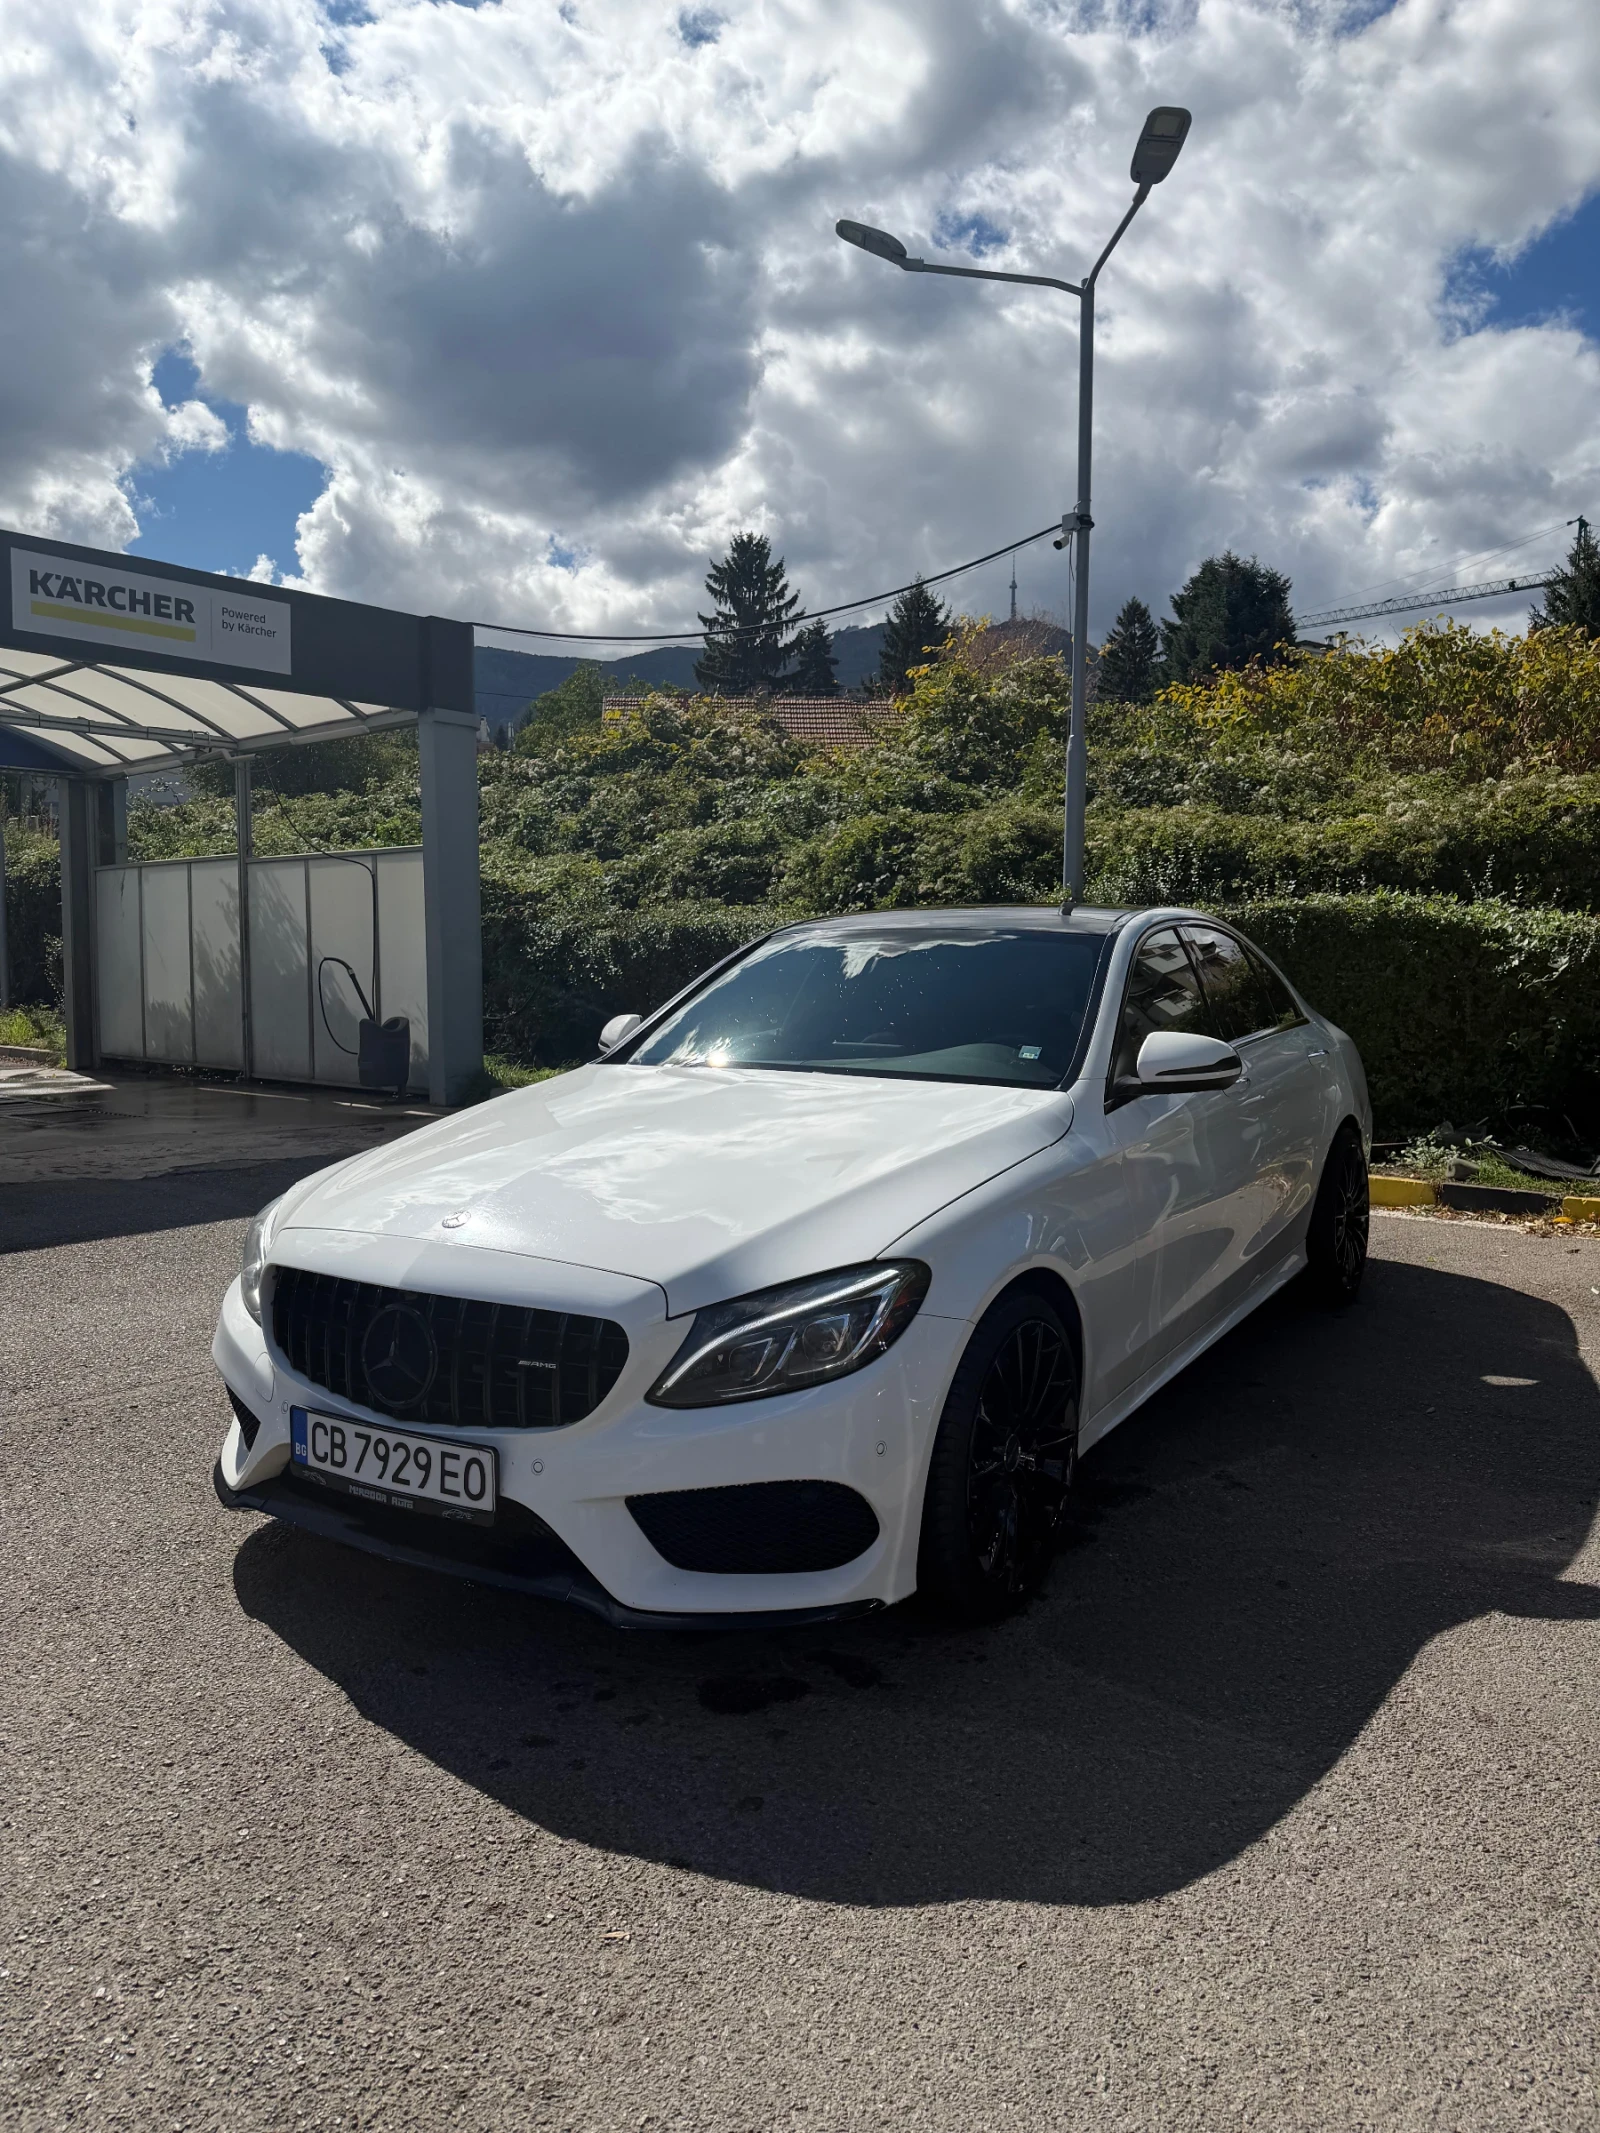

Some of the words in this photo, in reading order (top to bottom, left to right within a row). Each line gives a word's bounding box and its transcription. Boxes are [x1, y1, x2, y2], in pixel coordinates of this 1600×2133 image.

[29, 569, 195, 623] KÄRCHER
[222, 606, 266, 624] Powered
[222, 619, 235, 631] by
[238, 623, 276, 638] Kärcher
[530, 1361, 557, 1369] AMG
[295, 1442, 307, 1456] BG
[311, 1421, 347, 1468] CB
[354, 1431, 432, 1489] 7929
